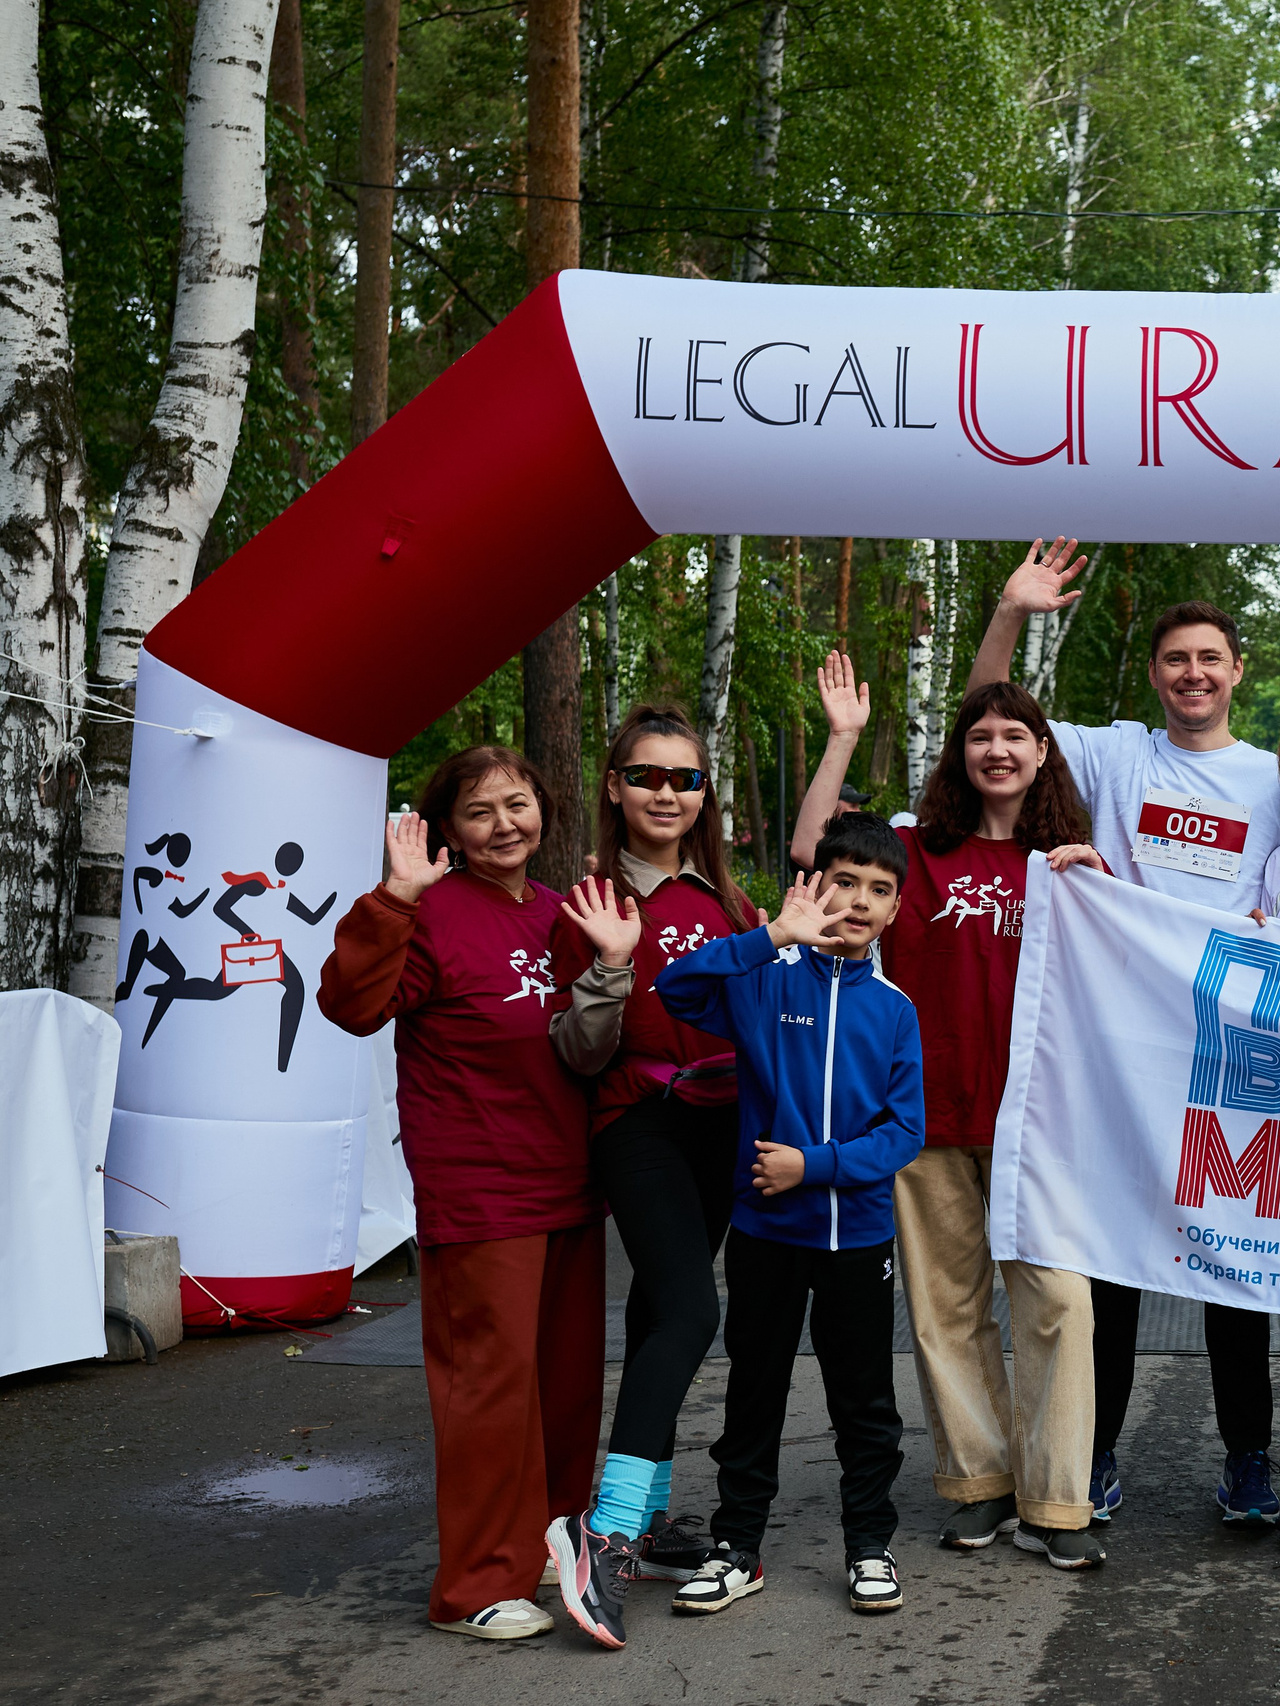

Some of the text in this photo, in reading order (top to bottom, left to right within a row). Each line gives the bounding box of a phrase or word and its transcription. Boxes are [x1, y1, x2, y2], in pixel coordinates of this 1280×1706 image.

[634, 337, 937, 430] LEGAL
[1166, 812, 1219, 843] 005
[1006, 899, 1026, 909] UR
[779, 1013, 815, 1026] ELME
[1186, 1253, 1263, 1286] Охрана
